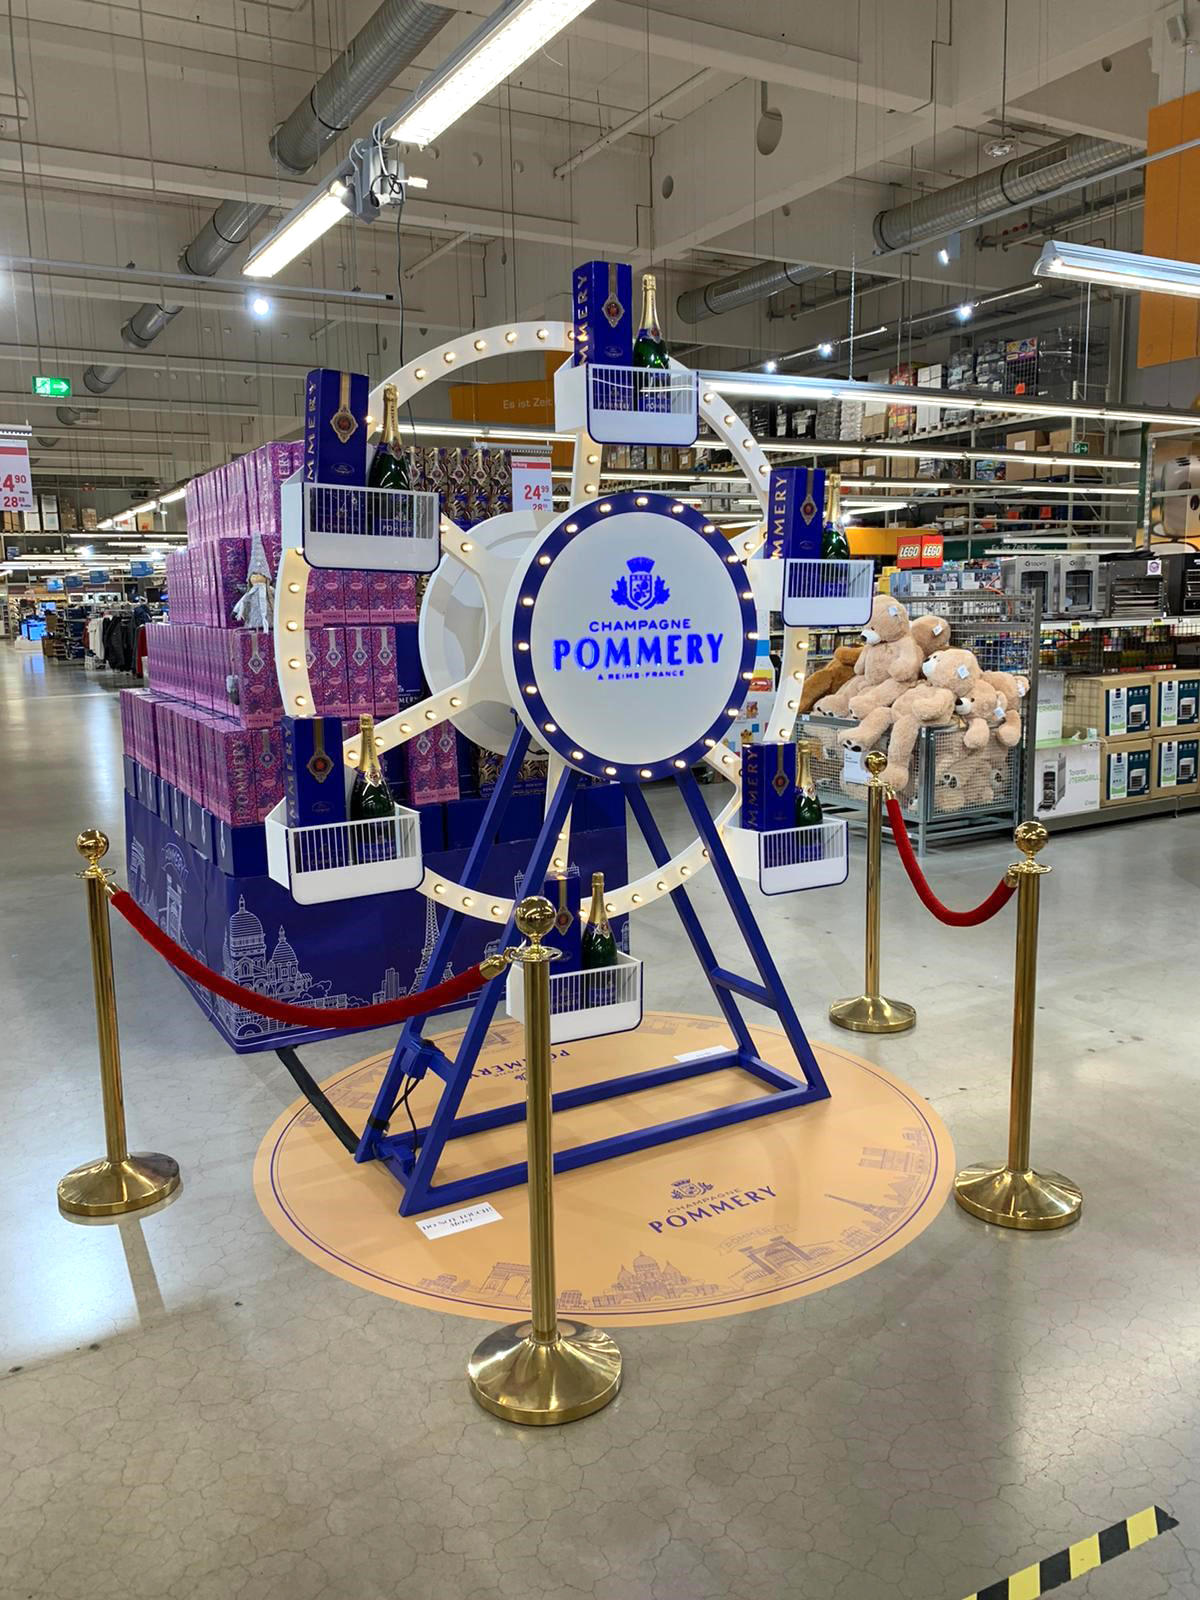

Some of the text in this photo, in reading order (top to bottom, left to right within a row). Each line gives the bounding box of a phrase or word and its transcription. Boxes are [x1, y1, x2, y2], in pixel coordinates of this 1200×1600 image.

[577, 275, 589, 365] MMERY
[307, 381, 317, 481] MMERY
[770, 476, 787, 560] MMERY
[899, 545, 920, 558] LEGO
[922, 544, 942, 558] LEGO
[589, 618, 691, 632] CHAMPAGNE
[553, 633, 723, 672] POMMERY
[747, 750, 758, 831] MMERY
[648, 1185, 776, 1233] POMMERY
